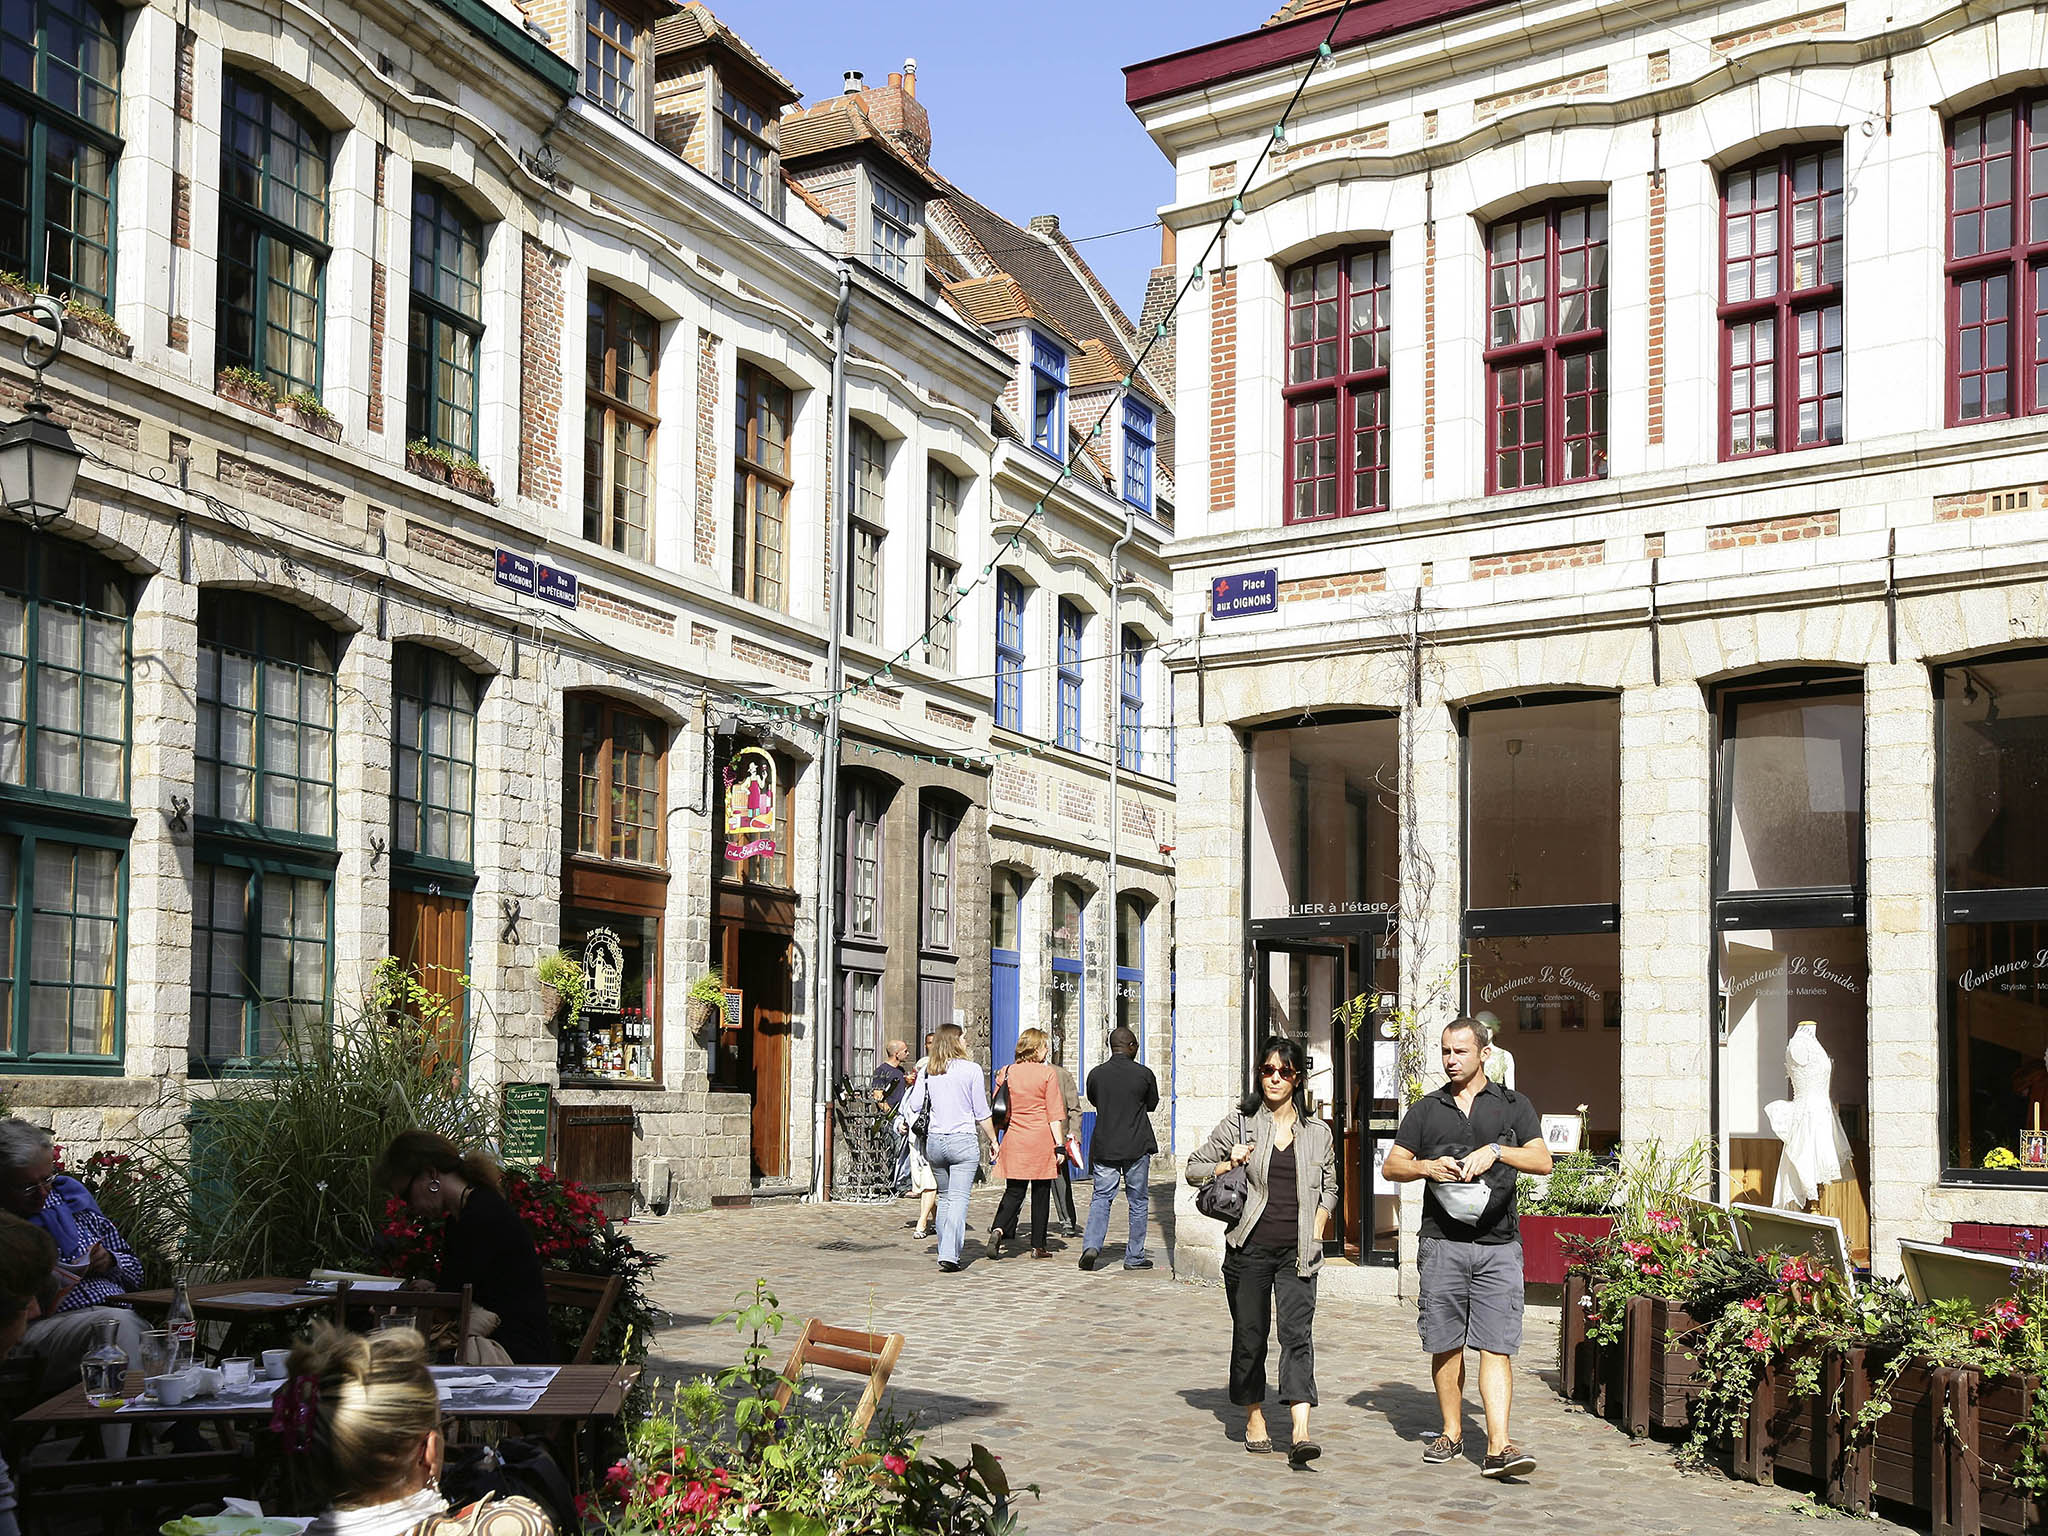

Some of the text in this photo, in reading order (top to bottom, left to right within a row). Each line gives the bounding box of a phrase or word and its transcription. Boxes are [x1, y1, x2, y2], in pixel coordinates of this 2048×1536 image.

[514, 560, 529, 573] Place
[498, 571, 533, 589] aux OIGNONS
[557, 575, 568, 587] Rue
[1243, 579, 1265, 590] Place
[538, 585, 546, 594] au
[1216, 593, 1272, 612] aux OIGNONS
[1328, 902, 1337, 913] à
[1341, 901, 1389, 913] l'étage
[1726, 956, 1861, 997] Constance Le Gonidec
[1959, 959, 2030, 992] Constance
[1480, 965, 1601, 1003] Constance Le Gonidec
[2000, 983, 2027, 991] Styliste
